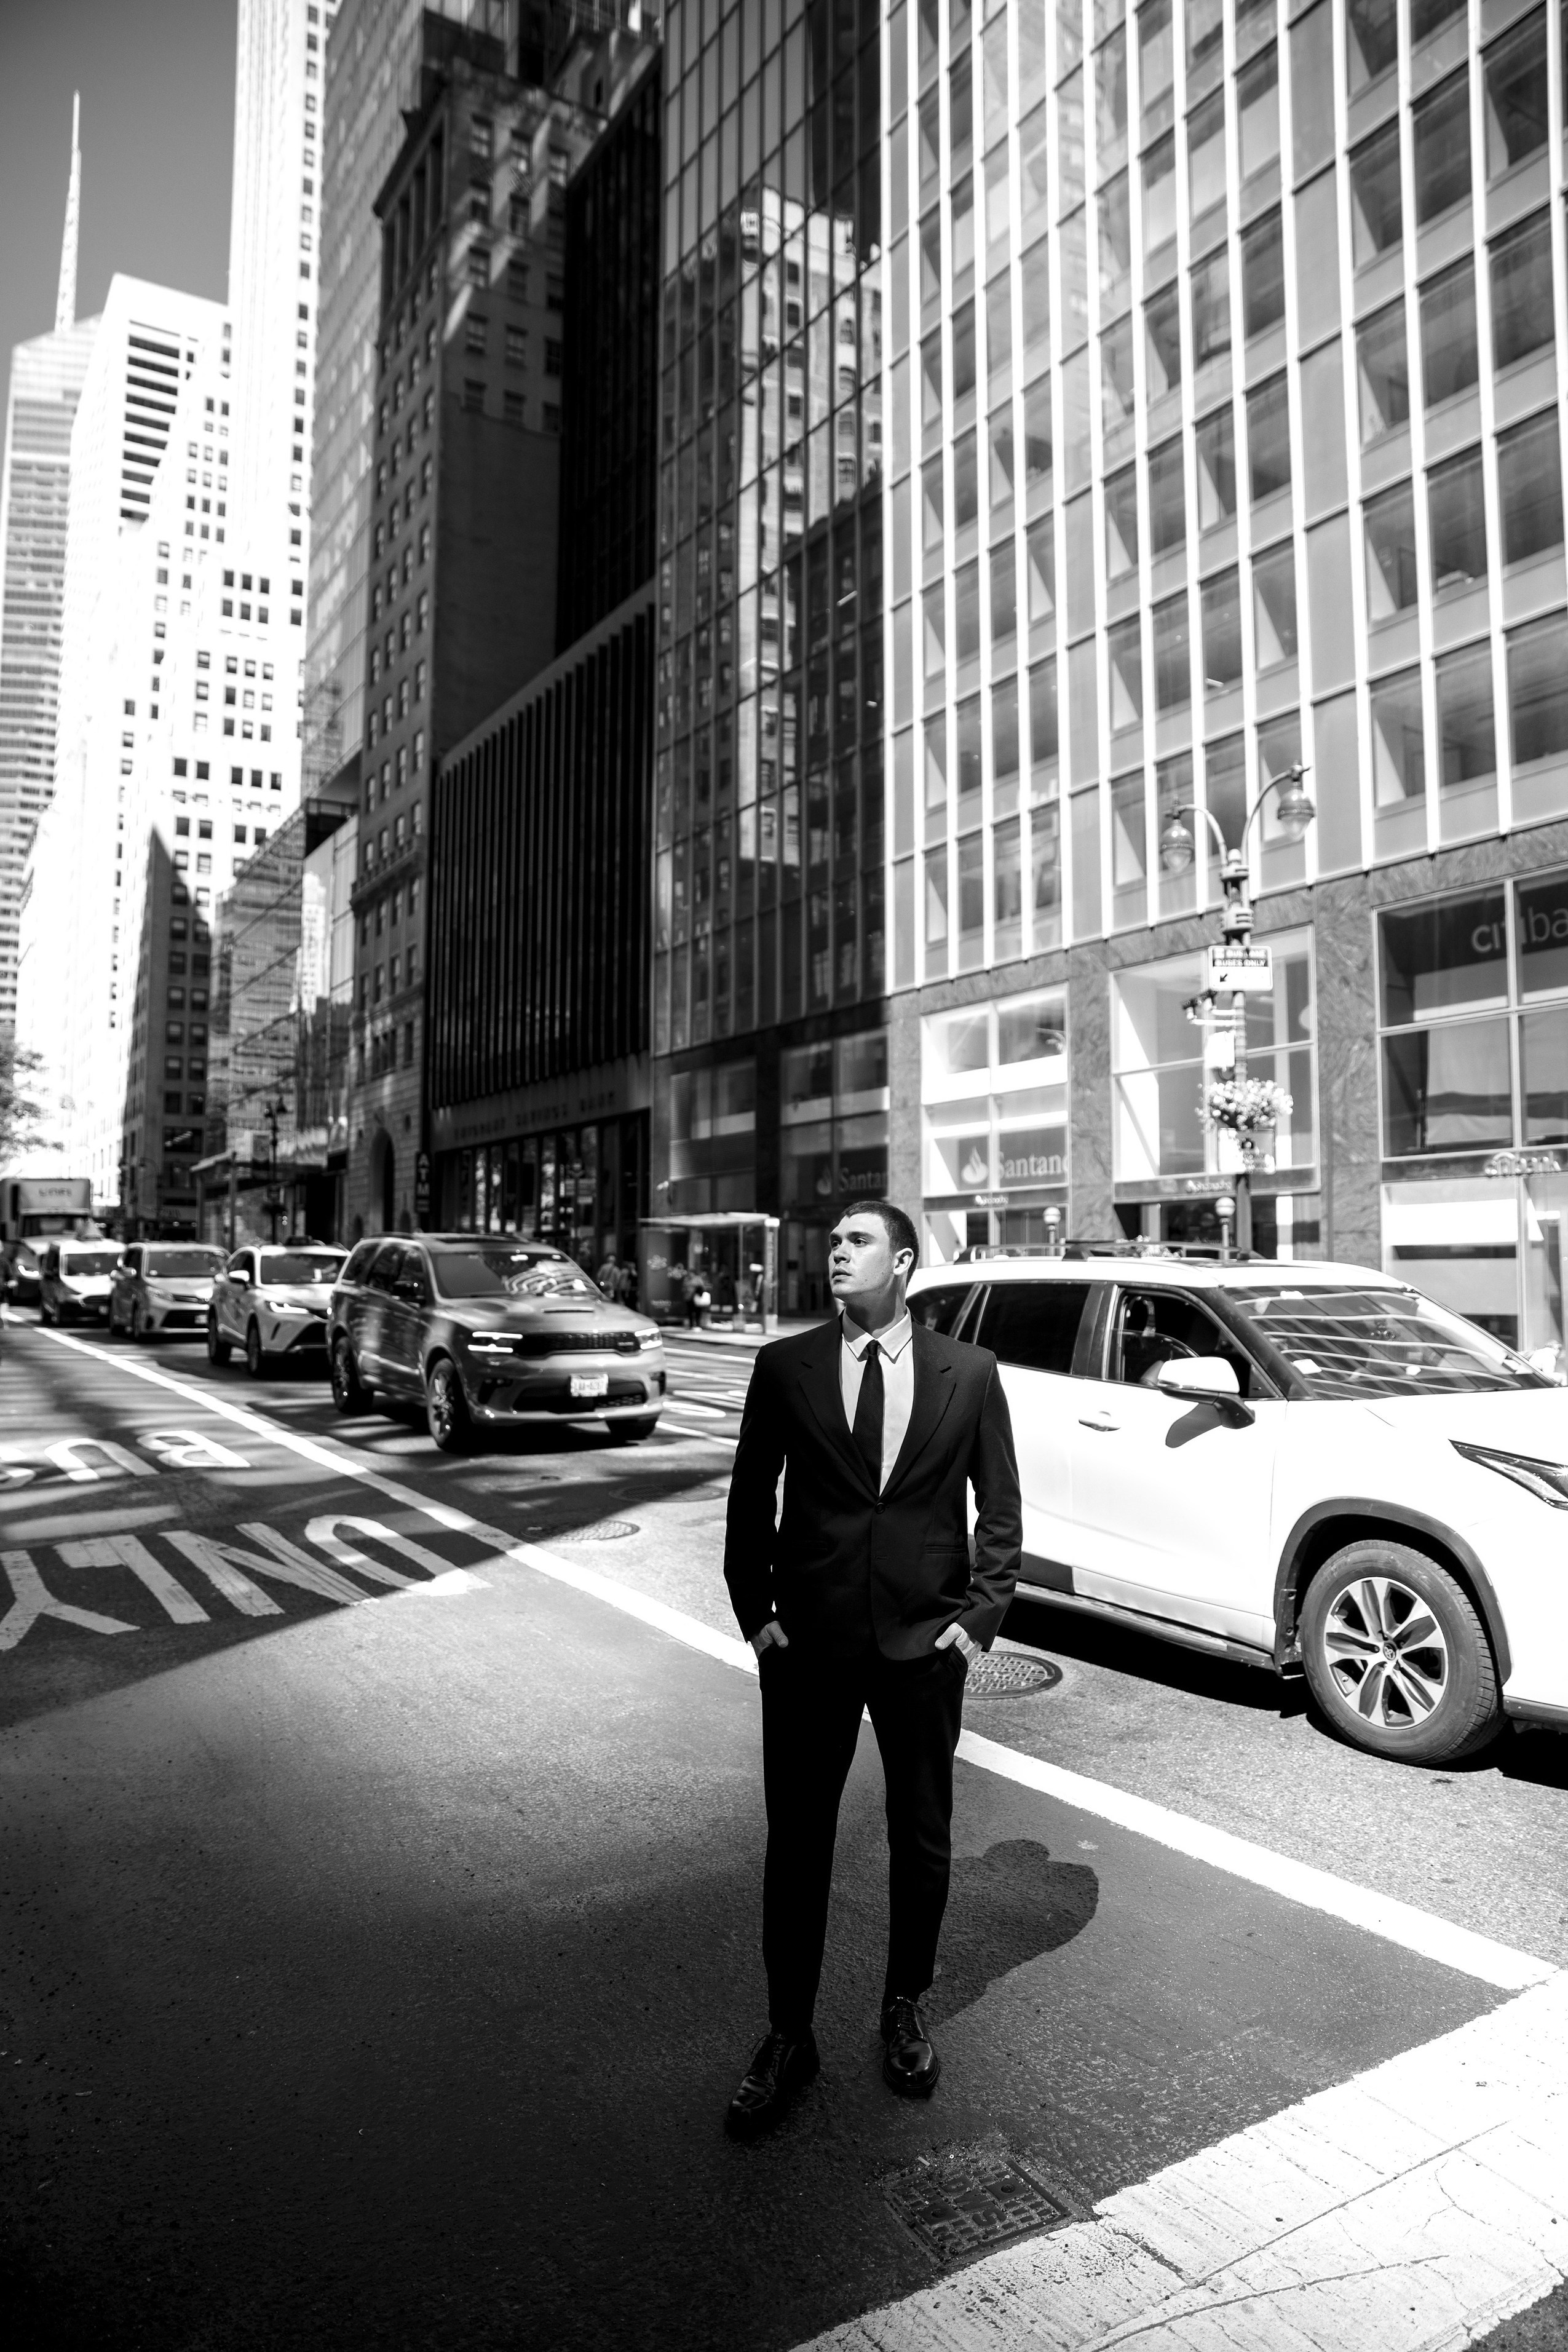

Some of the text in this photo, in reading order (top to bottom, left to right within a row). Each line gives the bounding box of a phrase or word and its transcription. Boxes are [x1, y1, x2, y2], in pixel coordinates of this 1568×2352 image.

[1226, 949, 1243, 958] BUS
[418, 1153, 430, 1196] ATM
[0, 1514, 493, 1652] ONLY
